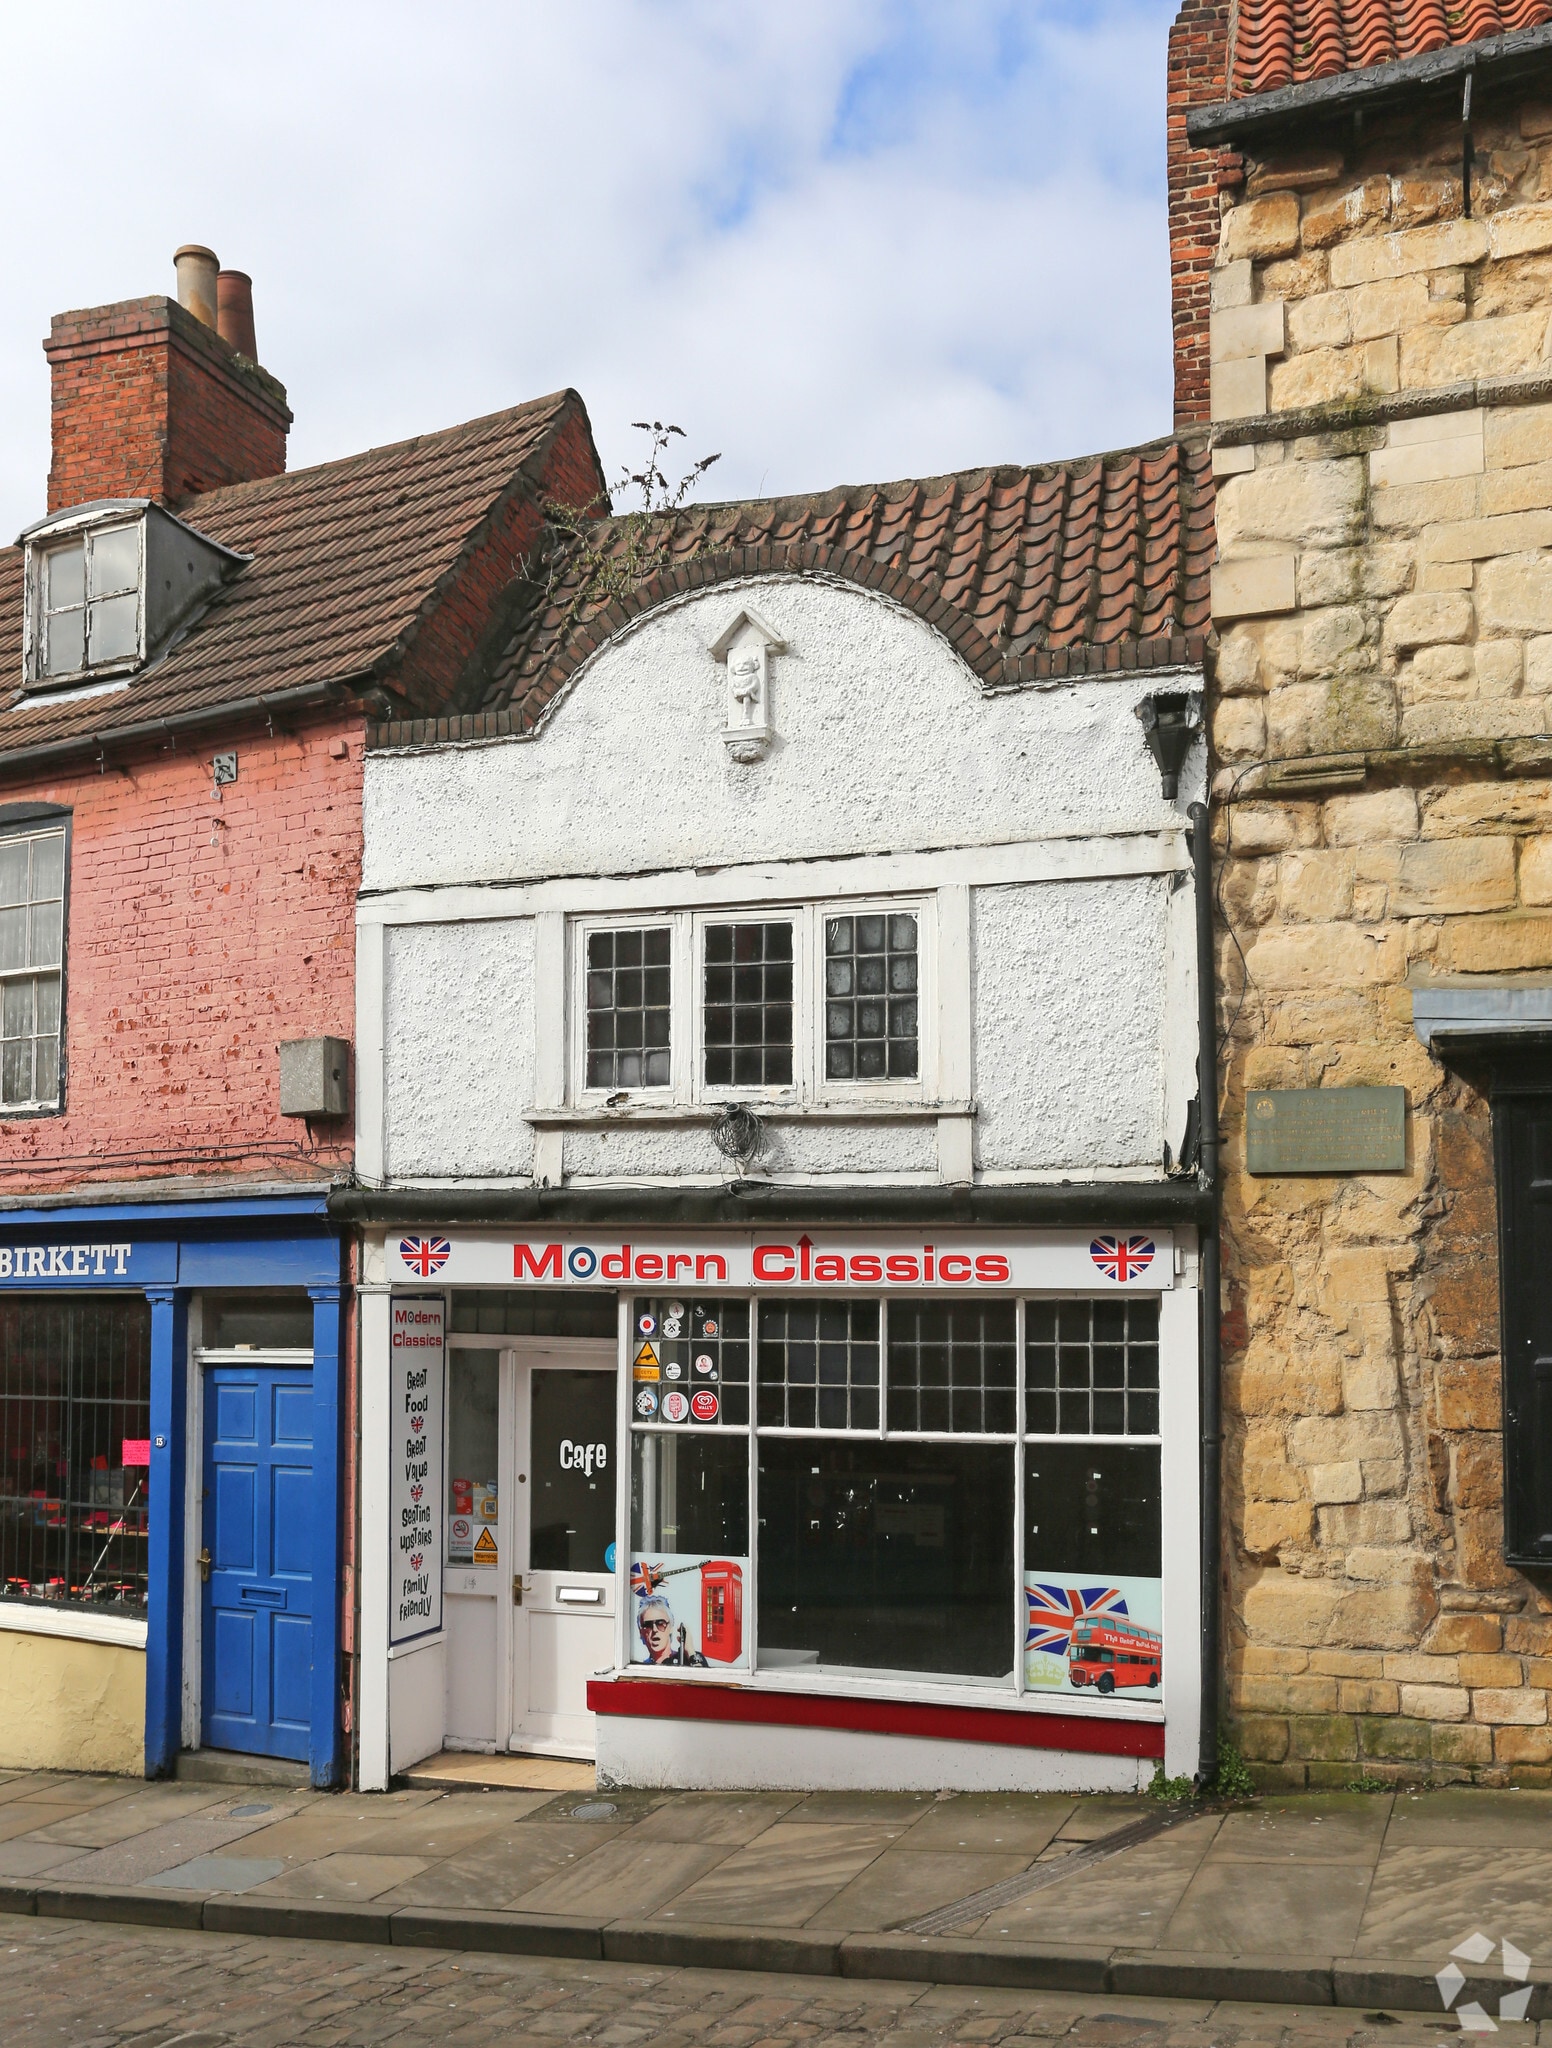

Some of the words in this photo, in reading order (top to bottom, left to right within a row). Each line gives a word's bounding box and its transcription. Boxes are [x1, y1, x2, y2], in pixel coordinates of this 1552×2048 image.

[0, 1243, 132, 1278] BIRKETT
[513, 1244, 727, 1280] Modern
[752, 1233, 1011, 1282] Classics
[395, 1310, 441, 1324] Modern
[393, 1330, 442, 1347] Classics
[405, 1394, 428, 1413] Food
[155, 1437, 163, 1446] 13
[560, 1439, 607, 1477] Cafe
[476, 1552, 497, 1560] Warning
